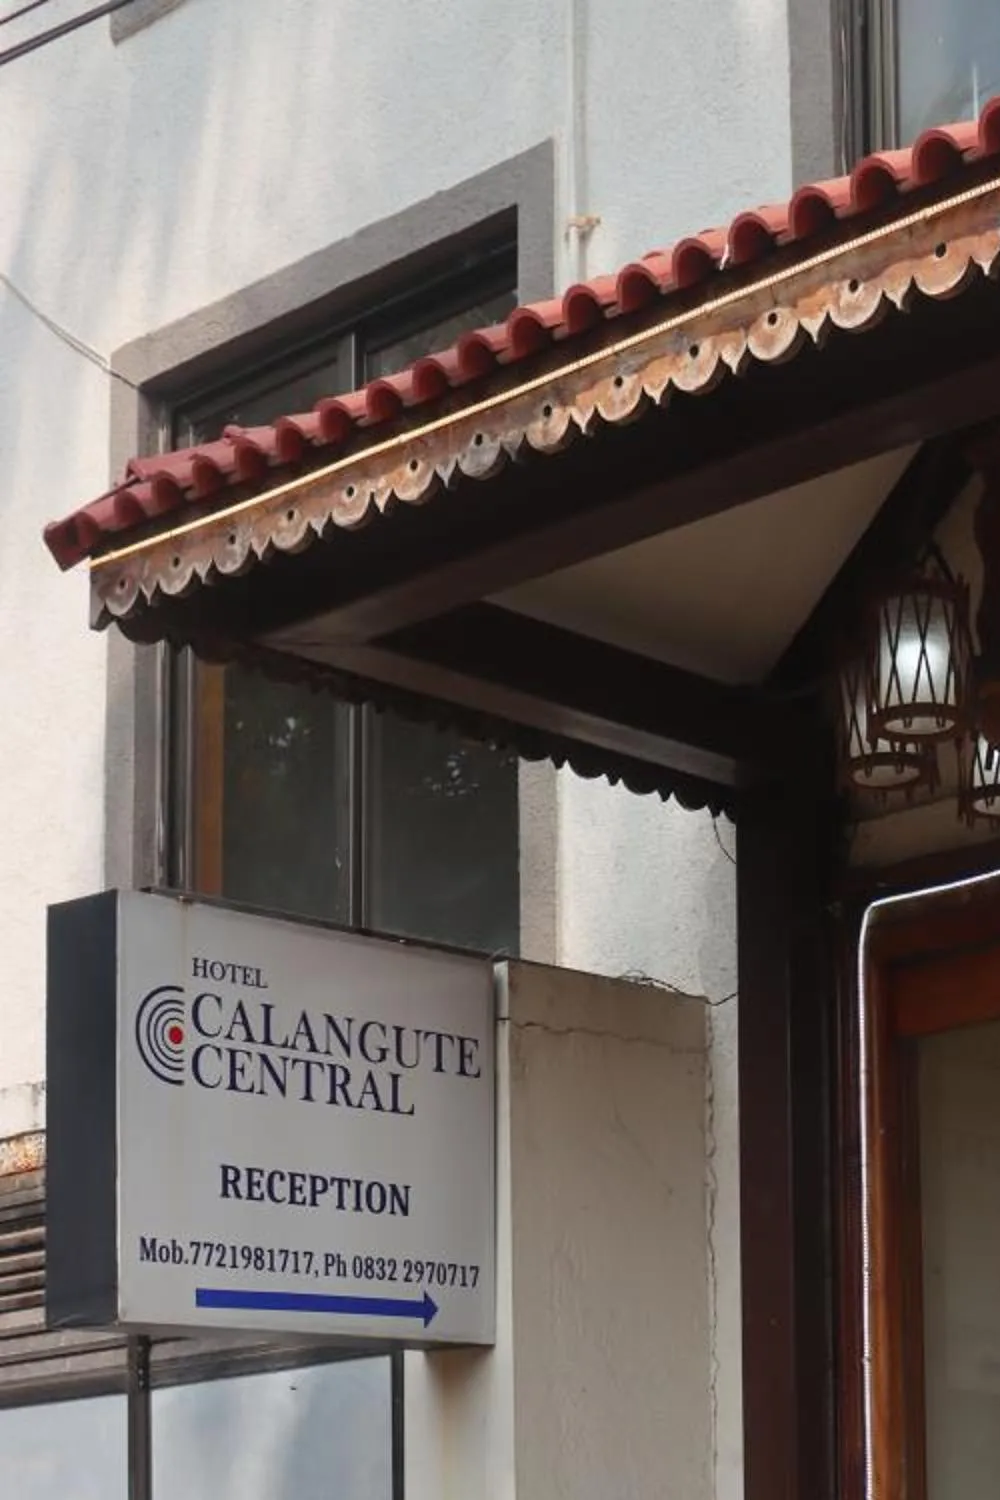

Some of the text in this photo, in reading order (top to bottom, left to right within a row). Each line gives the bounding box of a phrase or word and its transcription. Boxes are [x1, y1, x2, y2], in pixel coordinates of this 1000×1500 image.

[191, 957, 268, 990] HOTEL
[191, 992, 482, 1080] CALANGUTE
[191, 1043, 416, 1116] CENTRAL
[219, 1163, 412, 1217] RECEPTION
[323, 1252, 348, 1278] Ph
[352, 1254, 398, 1281] 0832
[402, 1259, 480, 1289] 2970717
